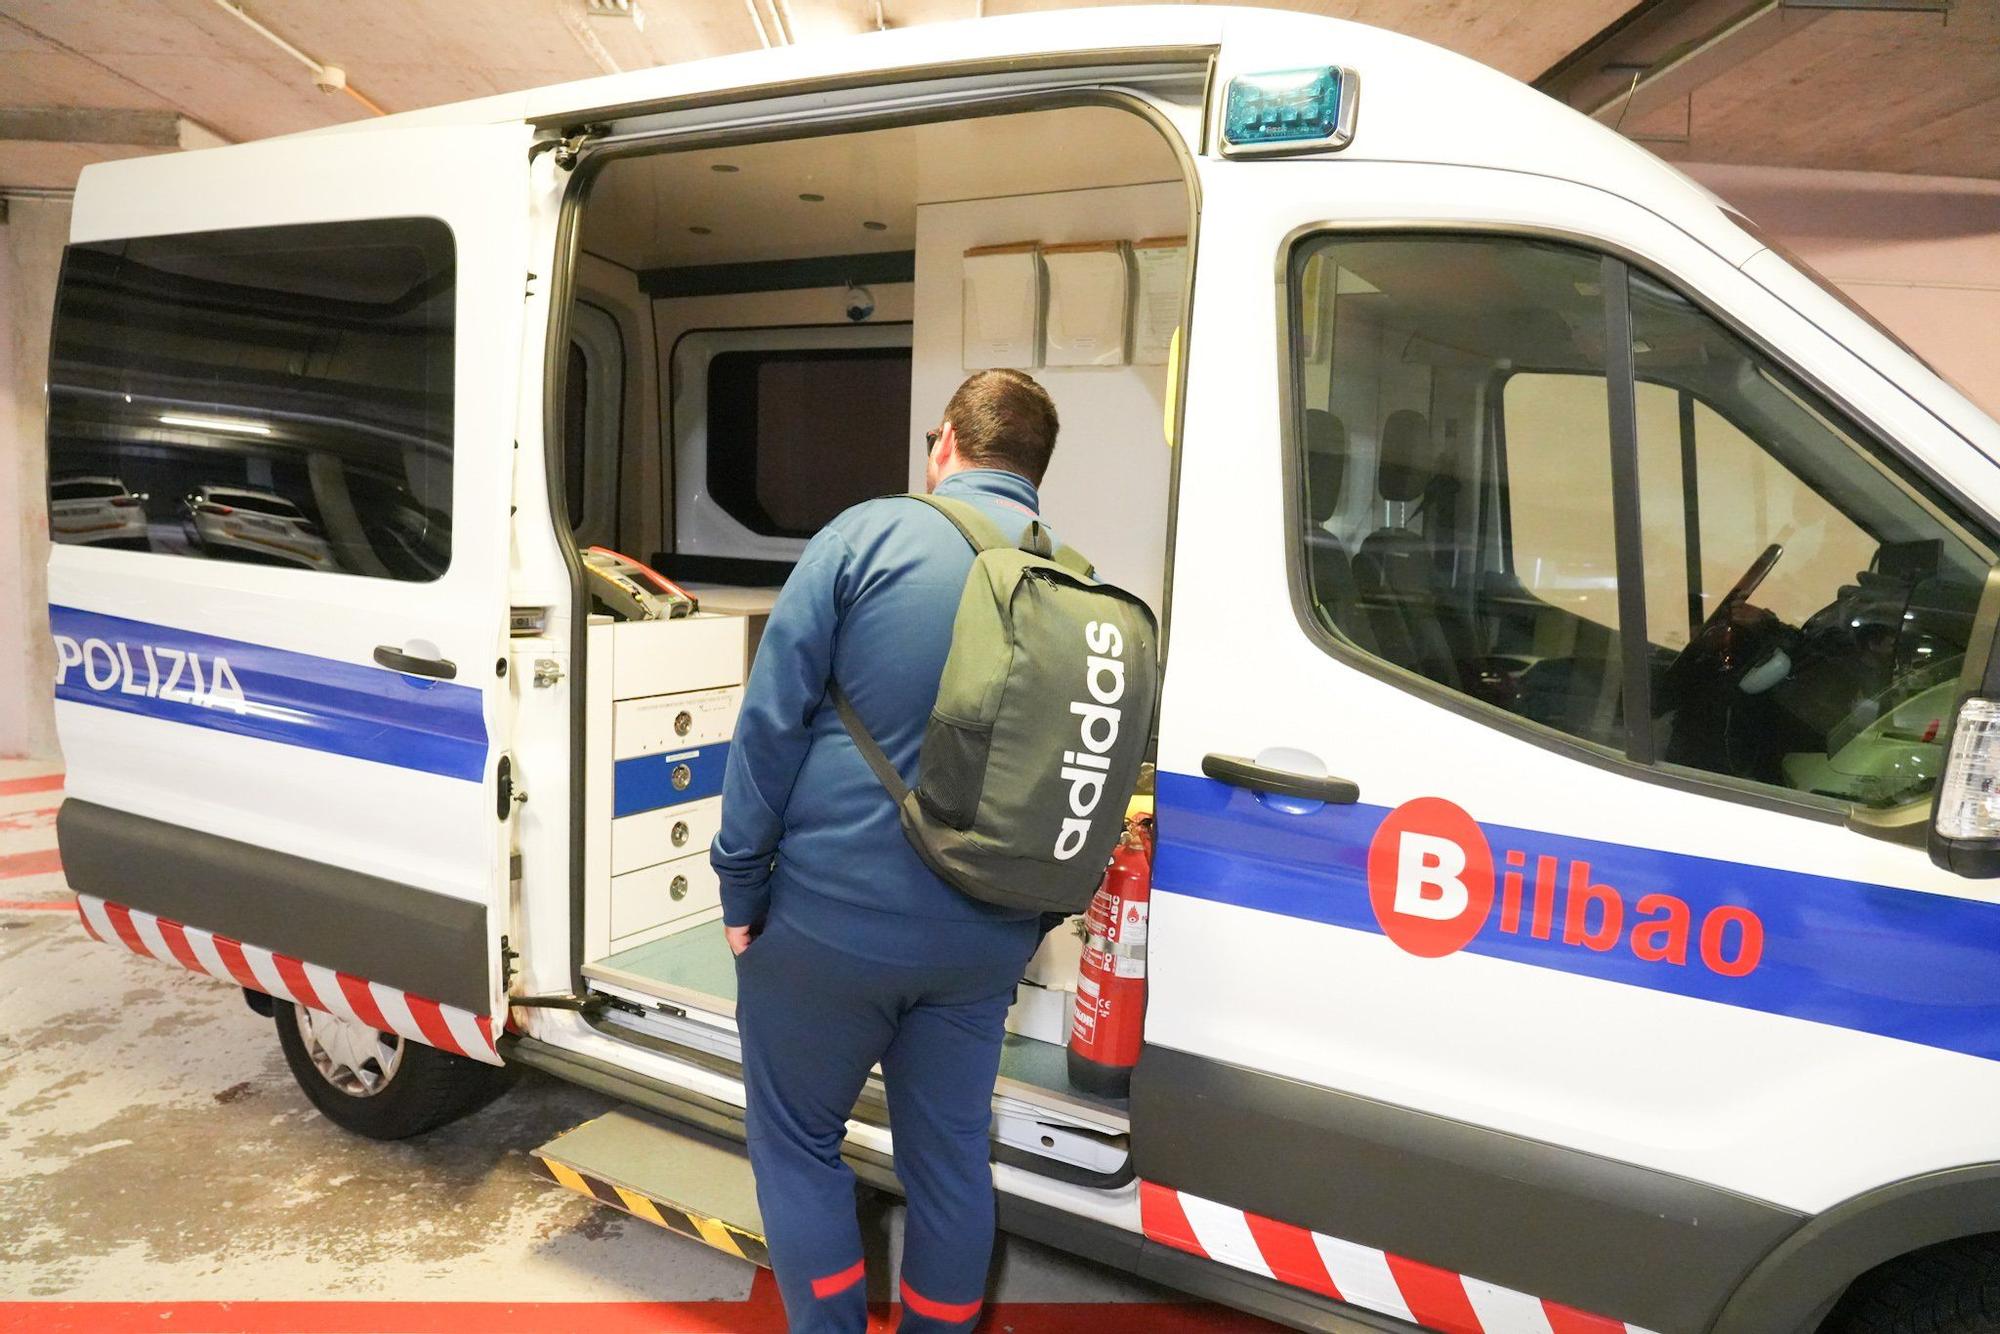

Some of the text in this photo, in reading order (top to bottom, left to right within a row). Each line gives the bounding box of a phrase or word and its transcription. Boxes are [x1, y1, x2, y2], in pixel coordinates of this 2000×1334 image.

[53, 634, 245, 715] POLIZIA
[1053, 620, 1125, 861] adidas
[1103, 895, 1120, 971] POO ABC
[1393, 830, 1764, 978] Bilbao
[1098, 998, 1112, 1010] CE
